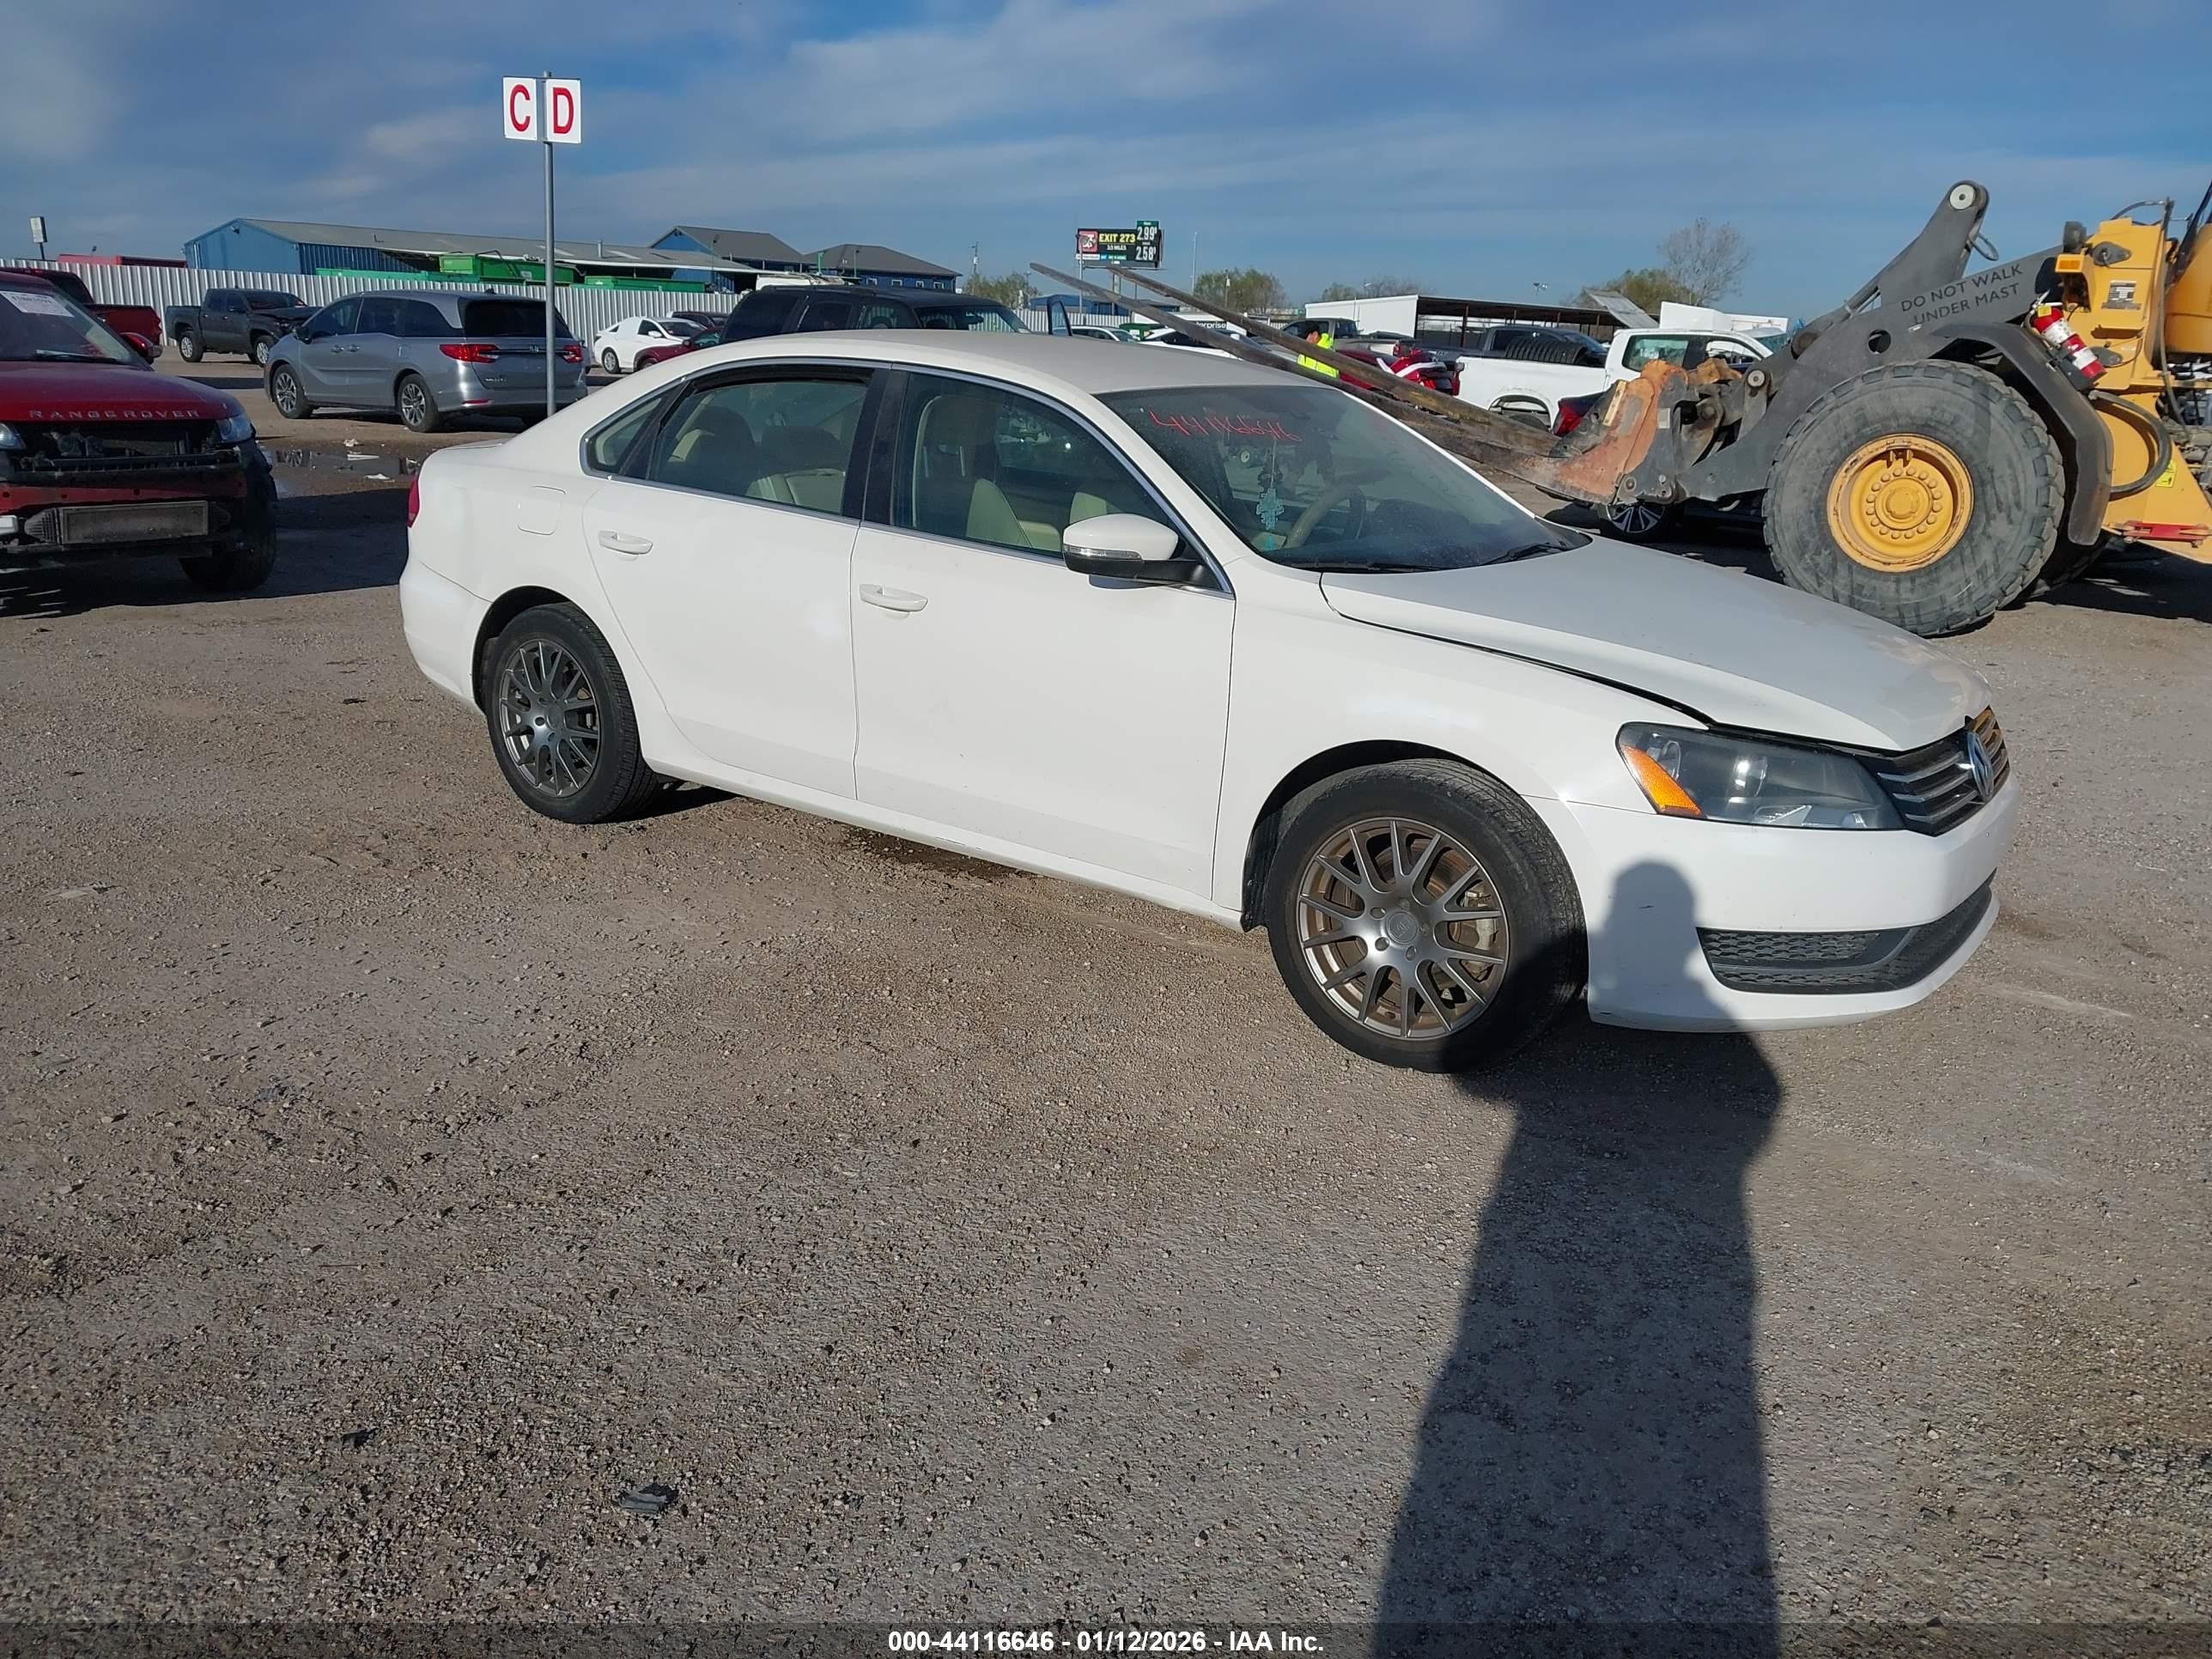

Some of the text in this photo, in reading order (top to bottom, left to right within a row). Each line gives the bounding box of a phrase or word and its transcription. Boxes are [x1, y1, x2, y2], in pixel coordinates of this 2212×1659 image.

[509, 83, 531, 132] C
[552, 87, 574, 135] D
[1098, 233, 1136, 243] EXIT 273
[1901, 264, 2023, 313] DO NOT WALK
[1913, 283, 2020, 325] UNDER MAST
[28, 410, 200, 419] RANGE ROVER
